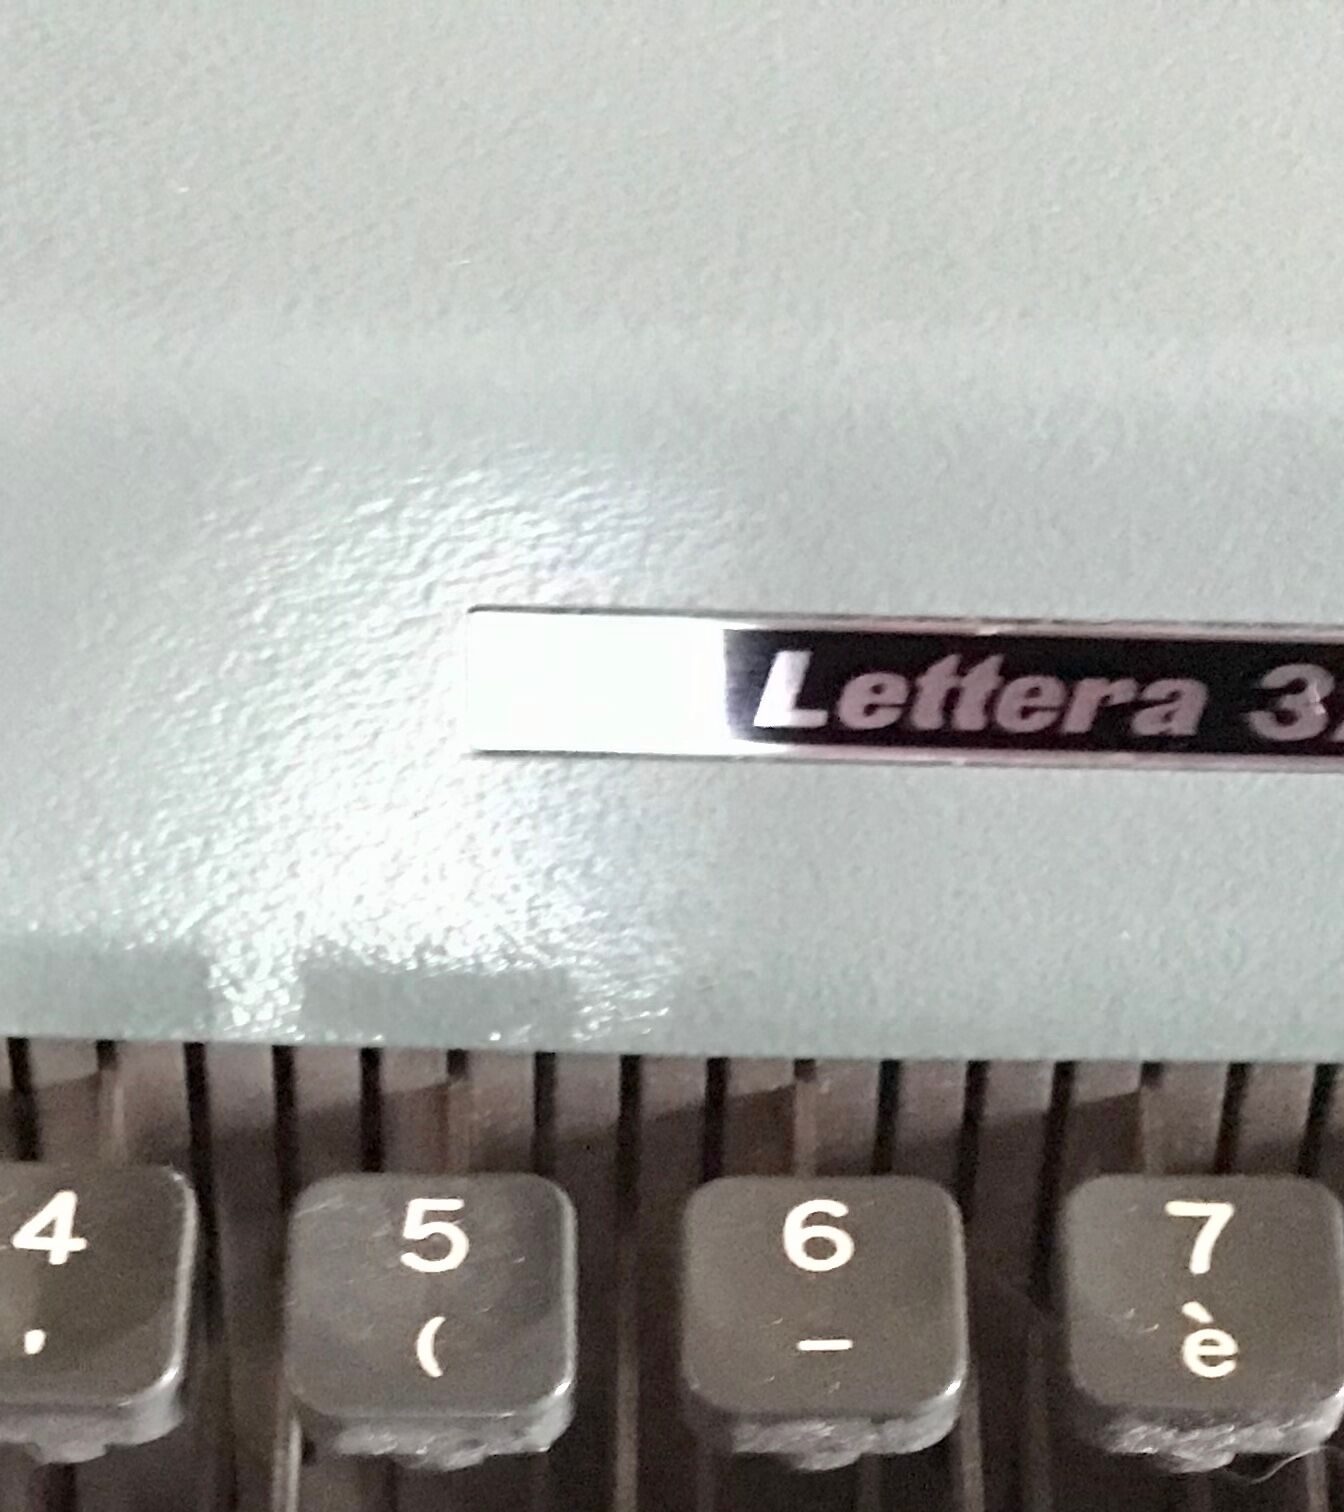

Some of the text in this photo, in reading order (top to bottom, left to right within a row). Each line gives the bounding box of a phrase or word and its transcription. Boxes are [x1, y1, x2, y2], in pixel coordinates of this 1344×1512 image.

[754, 651, 1203, 738] Lettera
[11, 1190, 88, 1266] 4
[399, 1196, 470, 1274] 5
[782, 1198, 855, 1273] 6
[1164, 1199, 1235, 1276] 7
[415, 1315, 446, 1379] (
[1181, 1300, 1239, 1379] è
